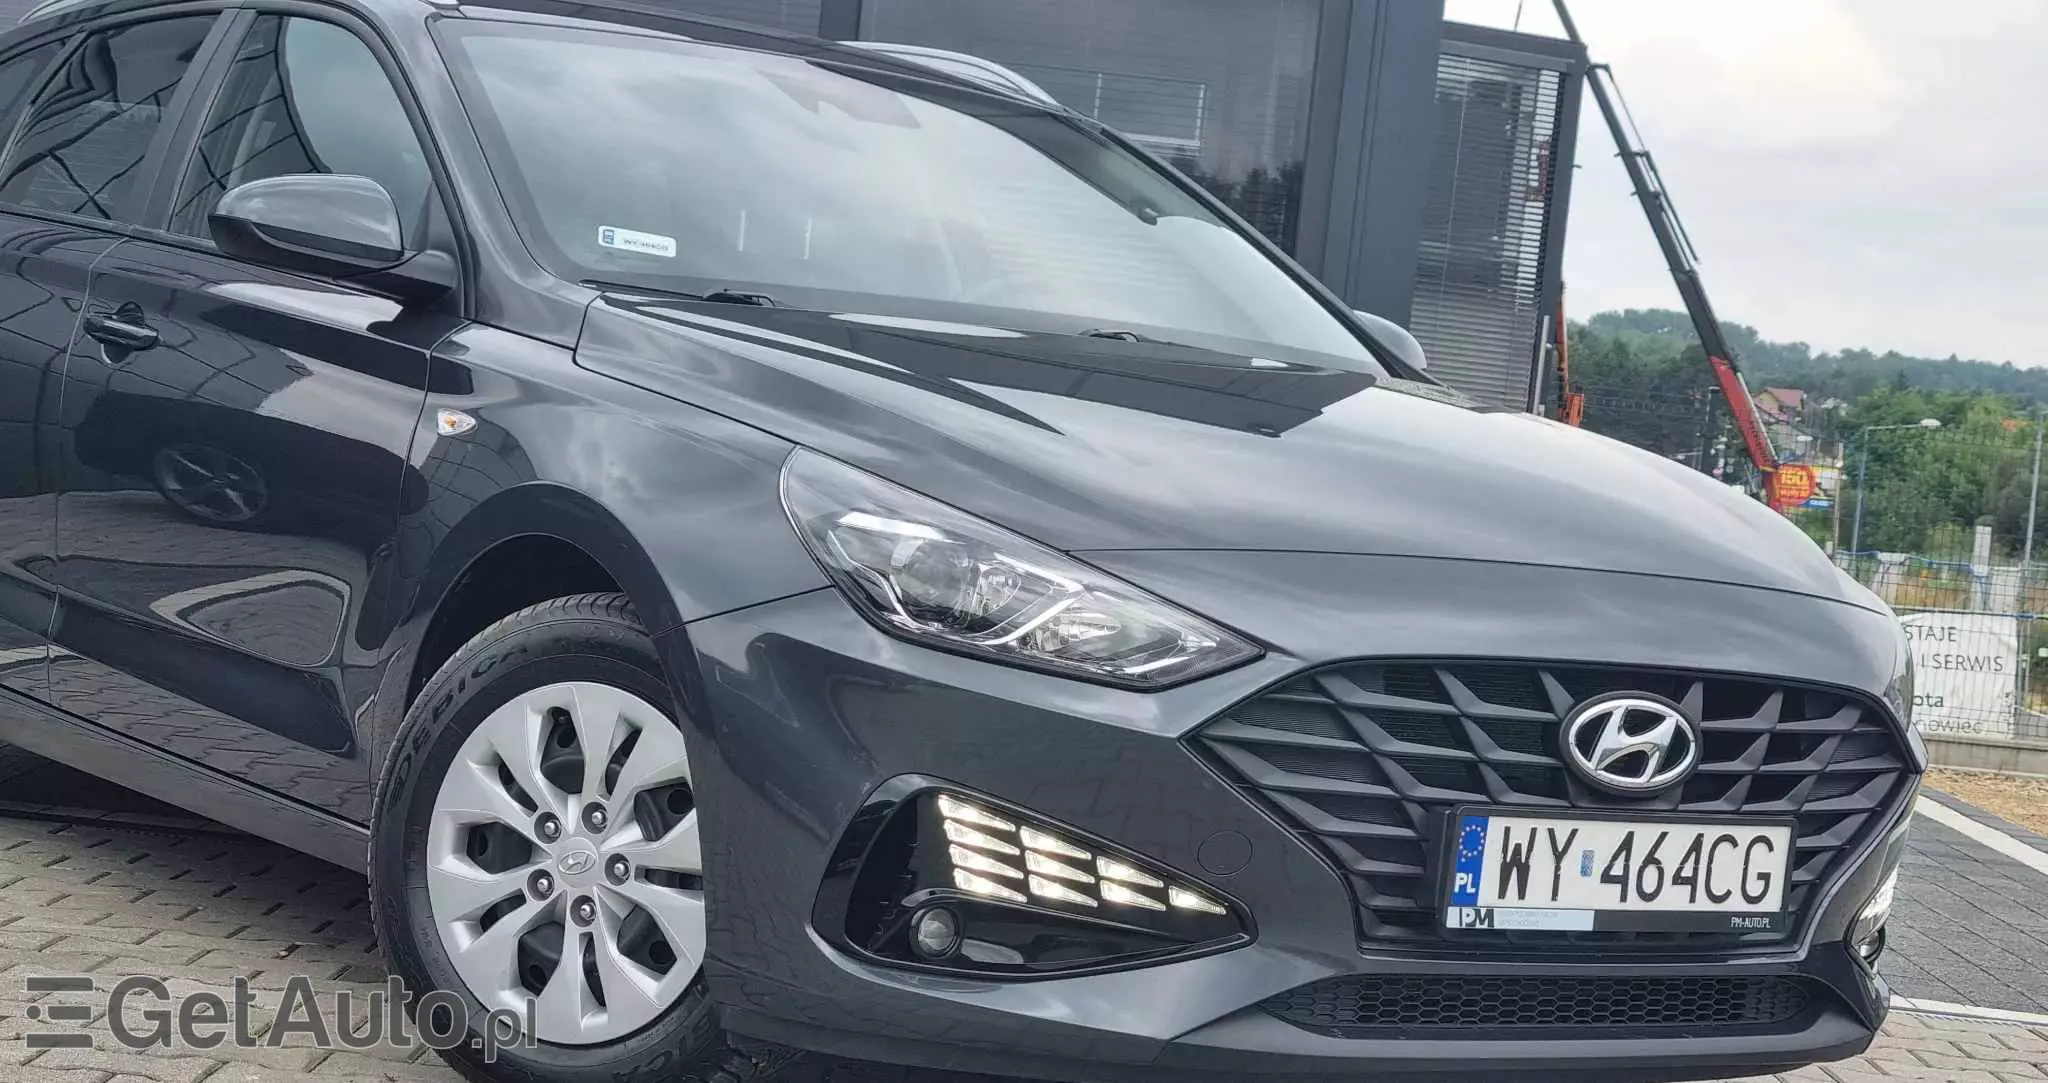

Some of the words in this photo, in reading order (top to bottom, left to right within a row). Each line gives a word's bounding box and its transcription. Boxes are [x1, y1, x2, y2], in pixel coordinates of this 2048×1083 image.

[1932, 653, 2004, 672] SERWIS
[1498, 825, 1579, 902] WY
[1600, 830, 1775, 905] 464CG
[1454, 872, 1477, 894] PL
[1730, 916, 1772, 929] PM-AUTO.PL
